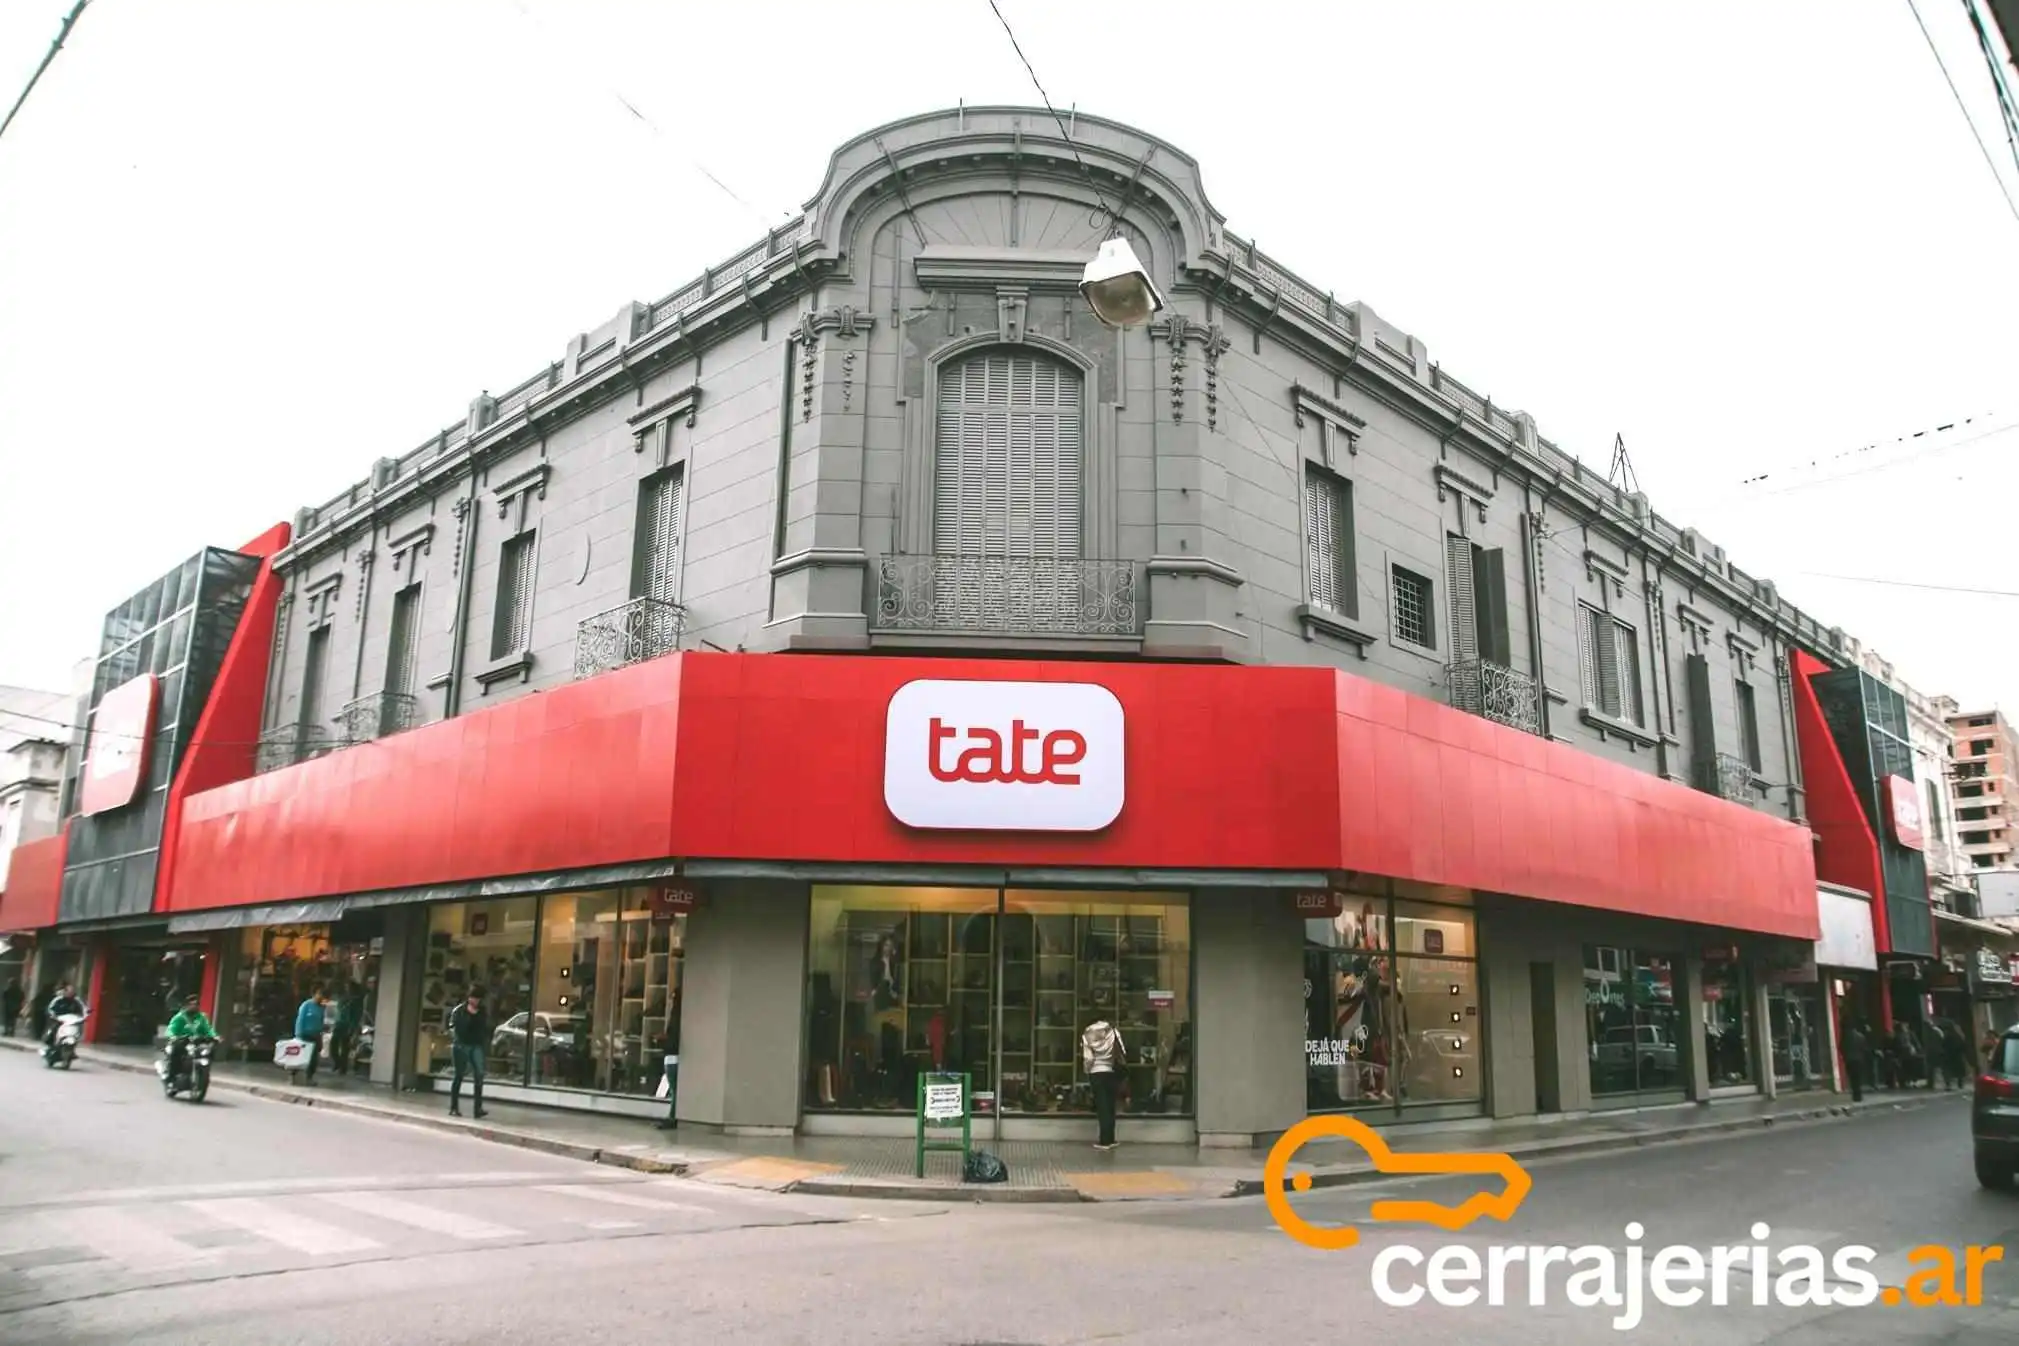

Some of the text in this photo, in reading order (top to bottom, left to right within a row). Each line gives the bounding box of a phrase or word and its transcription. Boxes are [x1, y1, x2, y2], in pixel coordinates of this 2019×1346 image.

[928, 717, 1087, 785] tate
[664, 888, 694, 904] tate
[1296, 893, 1327, 908] tate
[1330, 1040, 1350, 1053] QUE
[1310, 1052, 1346, 1067] HABLEN
